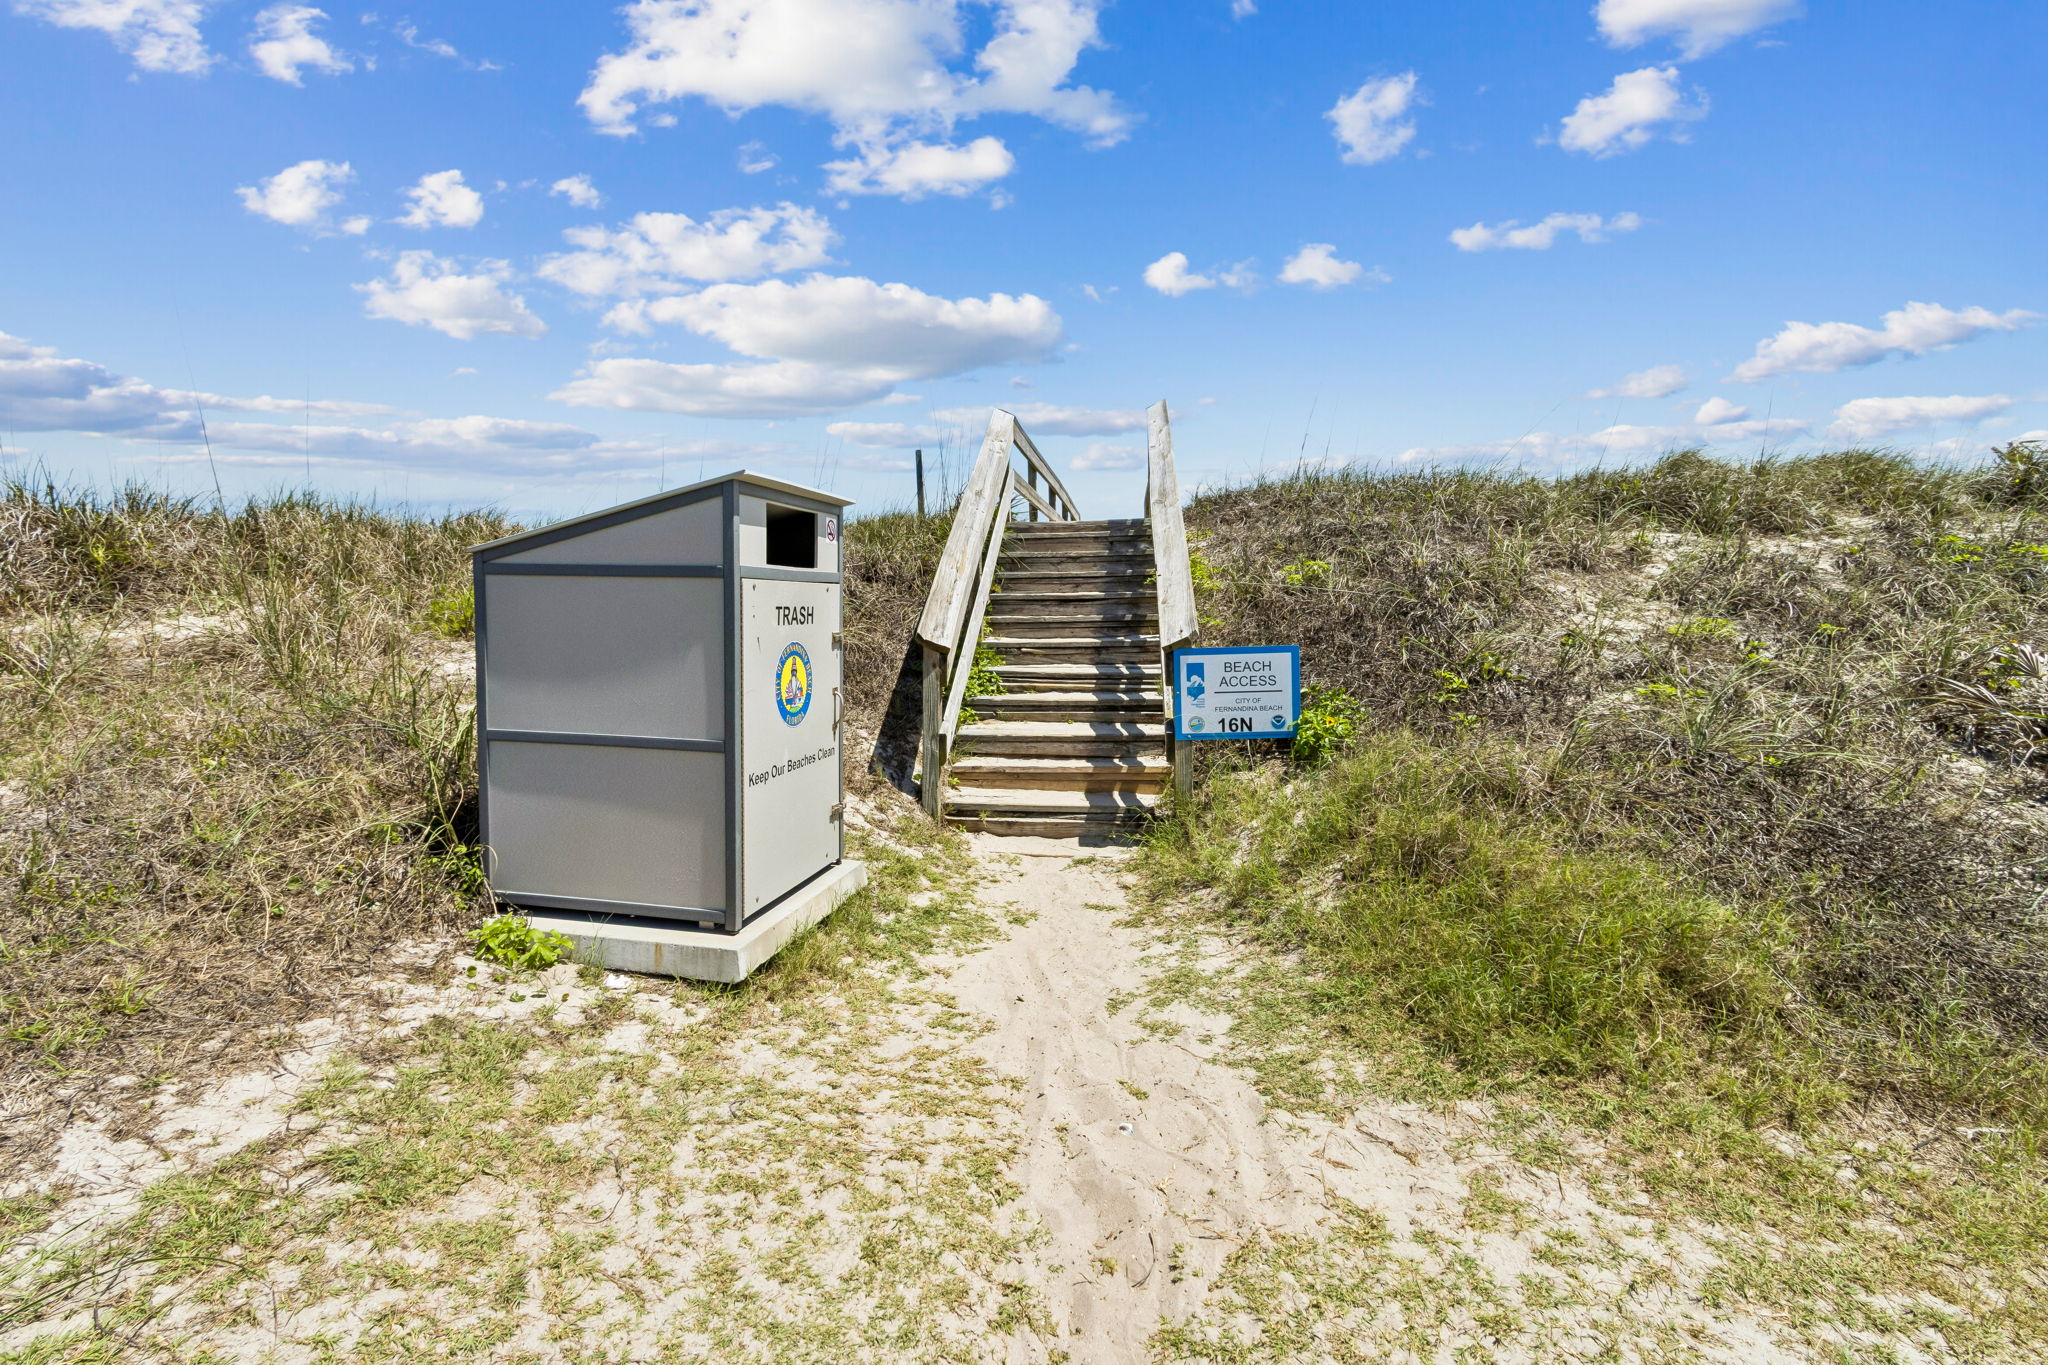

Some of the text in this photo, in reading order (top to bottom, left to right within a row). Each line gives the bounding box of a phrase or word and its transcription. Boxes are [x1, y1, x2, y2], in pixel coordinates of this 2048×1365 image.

[775, 606, 814, 626] TRASH
[1224, 661, 1272, 673] BEACH
[1219, 675, 1277, 687] ACCESS
[1214, 704, 1283, 713] FERNANDINA BEACH
[1218, 717, 1253, 733] 16N
[748, 746, 836, 787] Keep Our Beaches Clean
